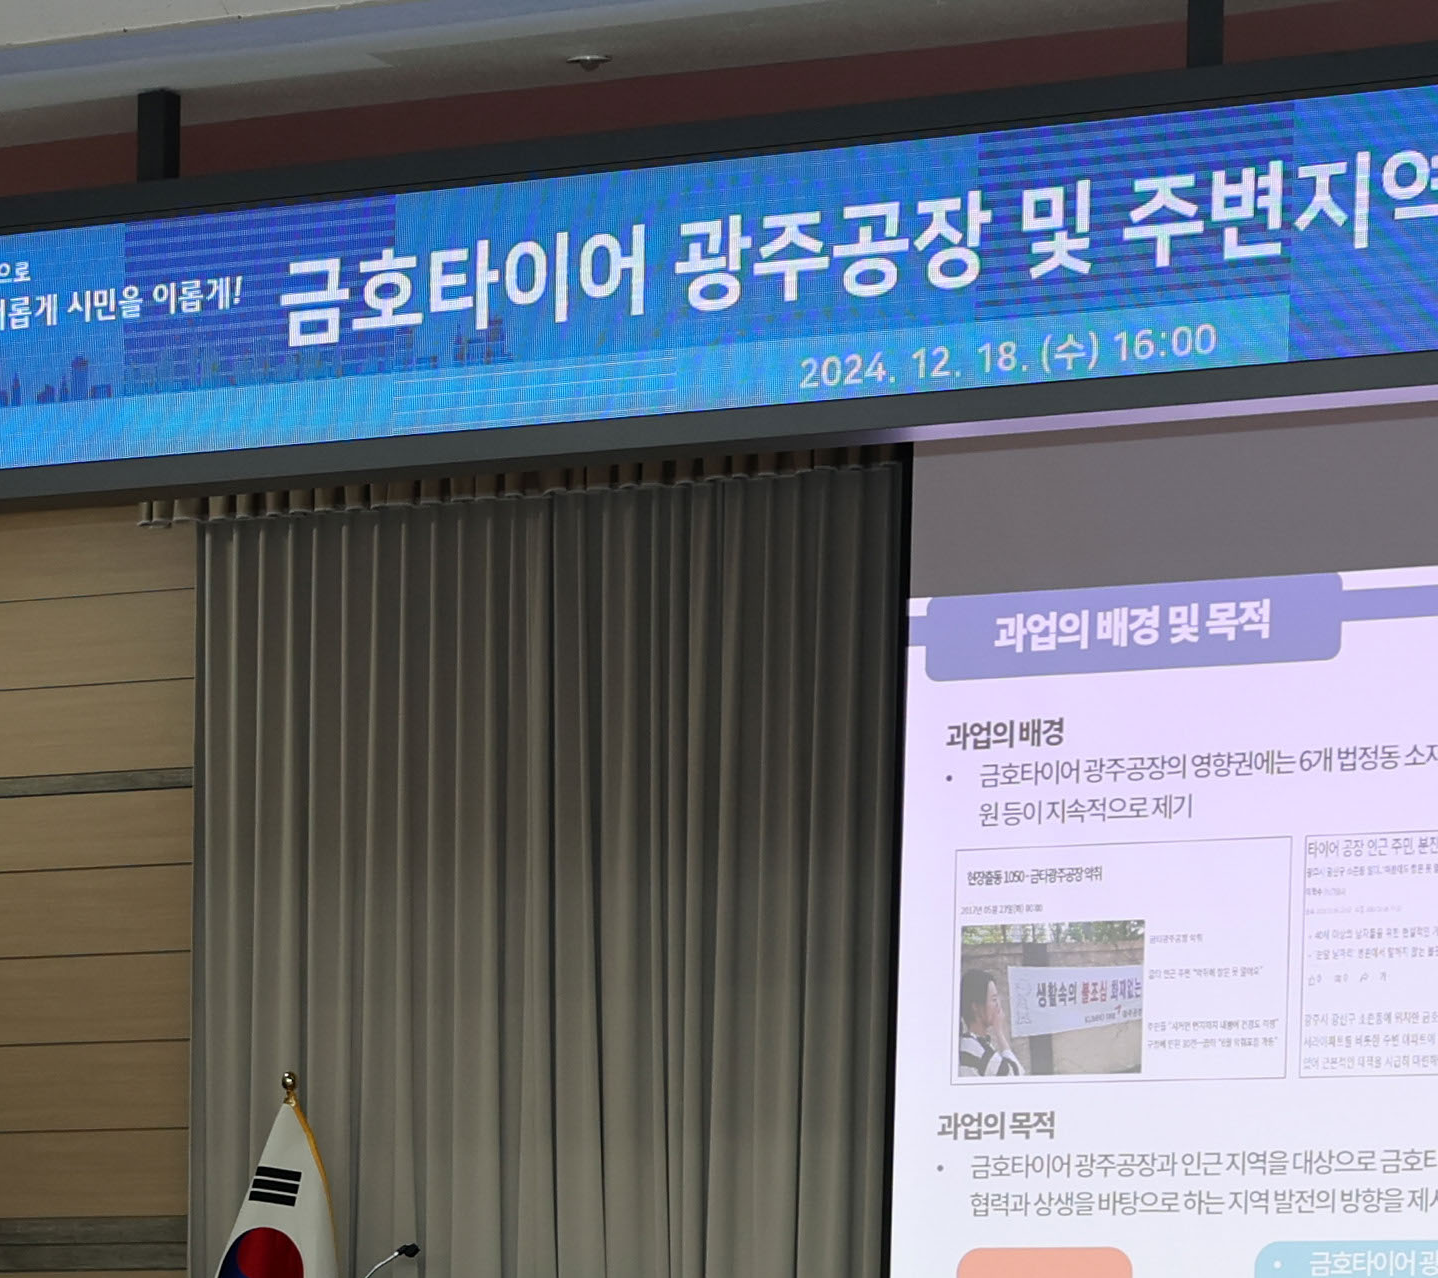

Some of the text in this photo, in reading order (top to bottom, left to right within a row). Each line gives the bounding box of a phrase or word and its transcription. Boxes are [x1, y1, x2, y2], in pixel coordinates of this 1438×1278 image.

[280, 222, 647, 348] 금호타이어
[674, 189, 992, 312] 광주공장
[1021, 179, 1092, 280] 및
[66, 284, 144, 323] 시민을
[152, 275, 246, 315] 이롭게!
[800, 322, 1217, 389] 2024. 12. 18. (수) 16:00
[994, 598, 1270, 653] 과업의 배경 및 목적
[945, 716, 1064, 751] 과업의 배경
[979, 758, 1080, 788] 금호타이어
[1083, 753, 1186, 783] 광주공장의
[1190, 749, 1297, 779] 영향권에는
[1299, 746, 1333, 773] 6개
[1337, 744, 1401, 772] 법정동
[978, 793, 1192, 827] 원 등이 지속적으로 제기
[937, 1110, 1055, 1141] 과업의 목적
[970, 1152, 1071, 1180] 금호타이어
[1074, 1151, 1178, 1178] 광주공장과
[1181, 1150, 1223, 1177] 인근
[1225, 1149, 1289, 1176] 지역을
[1292, 1148, 1378, 1175] 대상으로
[969, 1191, 1031, 1217] 협력과
[1033, 1191, 1095, 1217] 상생을
[1097, 1190, 1180, 1216] 바탕으로
[1182, 1189, 1225, 1216] 하는
[1228, 1188, 1269, 1215] 지역
[1273, 1188, 1336, 1214] 발전의
[1340, 1187, 1405, 1214] 방향을
[1309, 1249, 1416, 1277] 금호타이어
